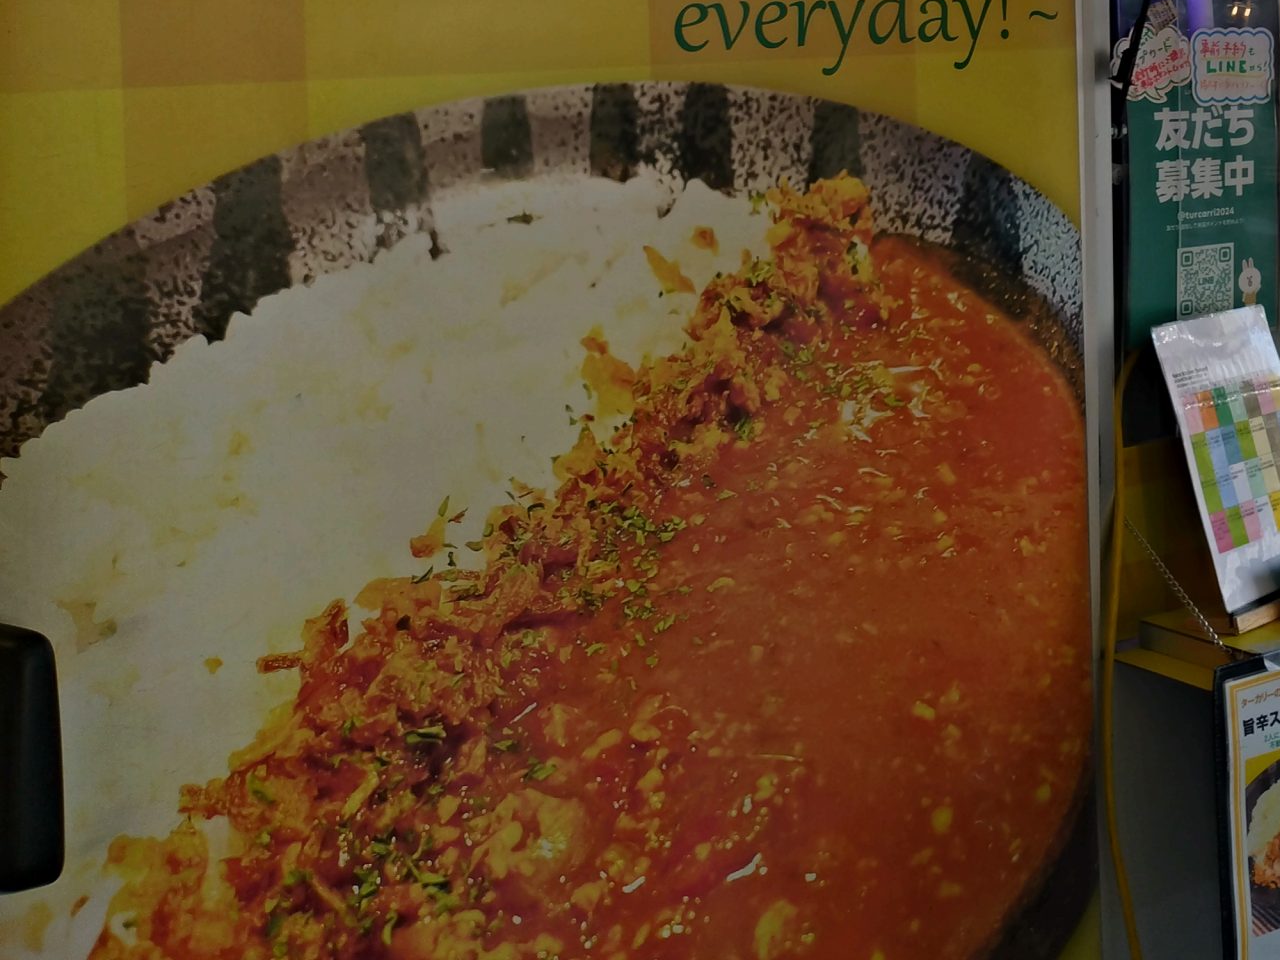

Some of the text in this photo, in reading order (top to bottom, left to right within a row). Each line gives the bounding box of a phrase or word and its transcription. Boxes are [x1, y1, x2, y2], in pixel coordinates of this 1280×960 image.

[1153, 105, 1255, 151] 友だち
[1155, 155, 1255, 204] 募集中
[1177, 206, 1235, 221] @turcarri2024
